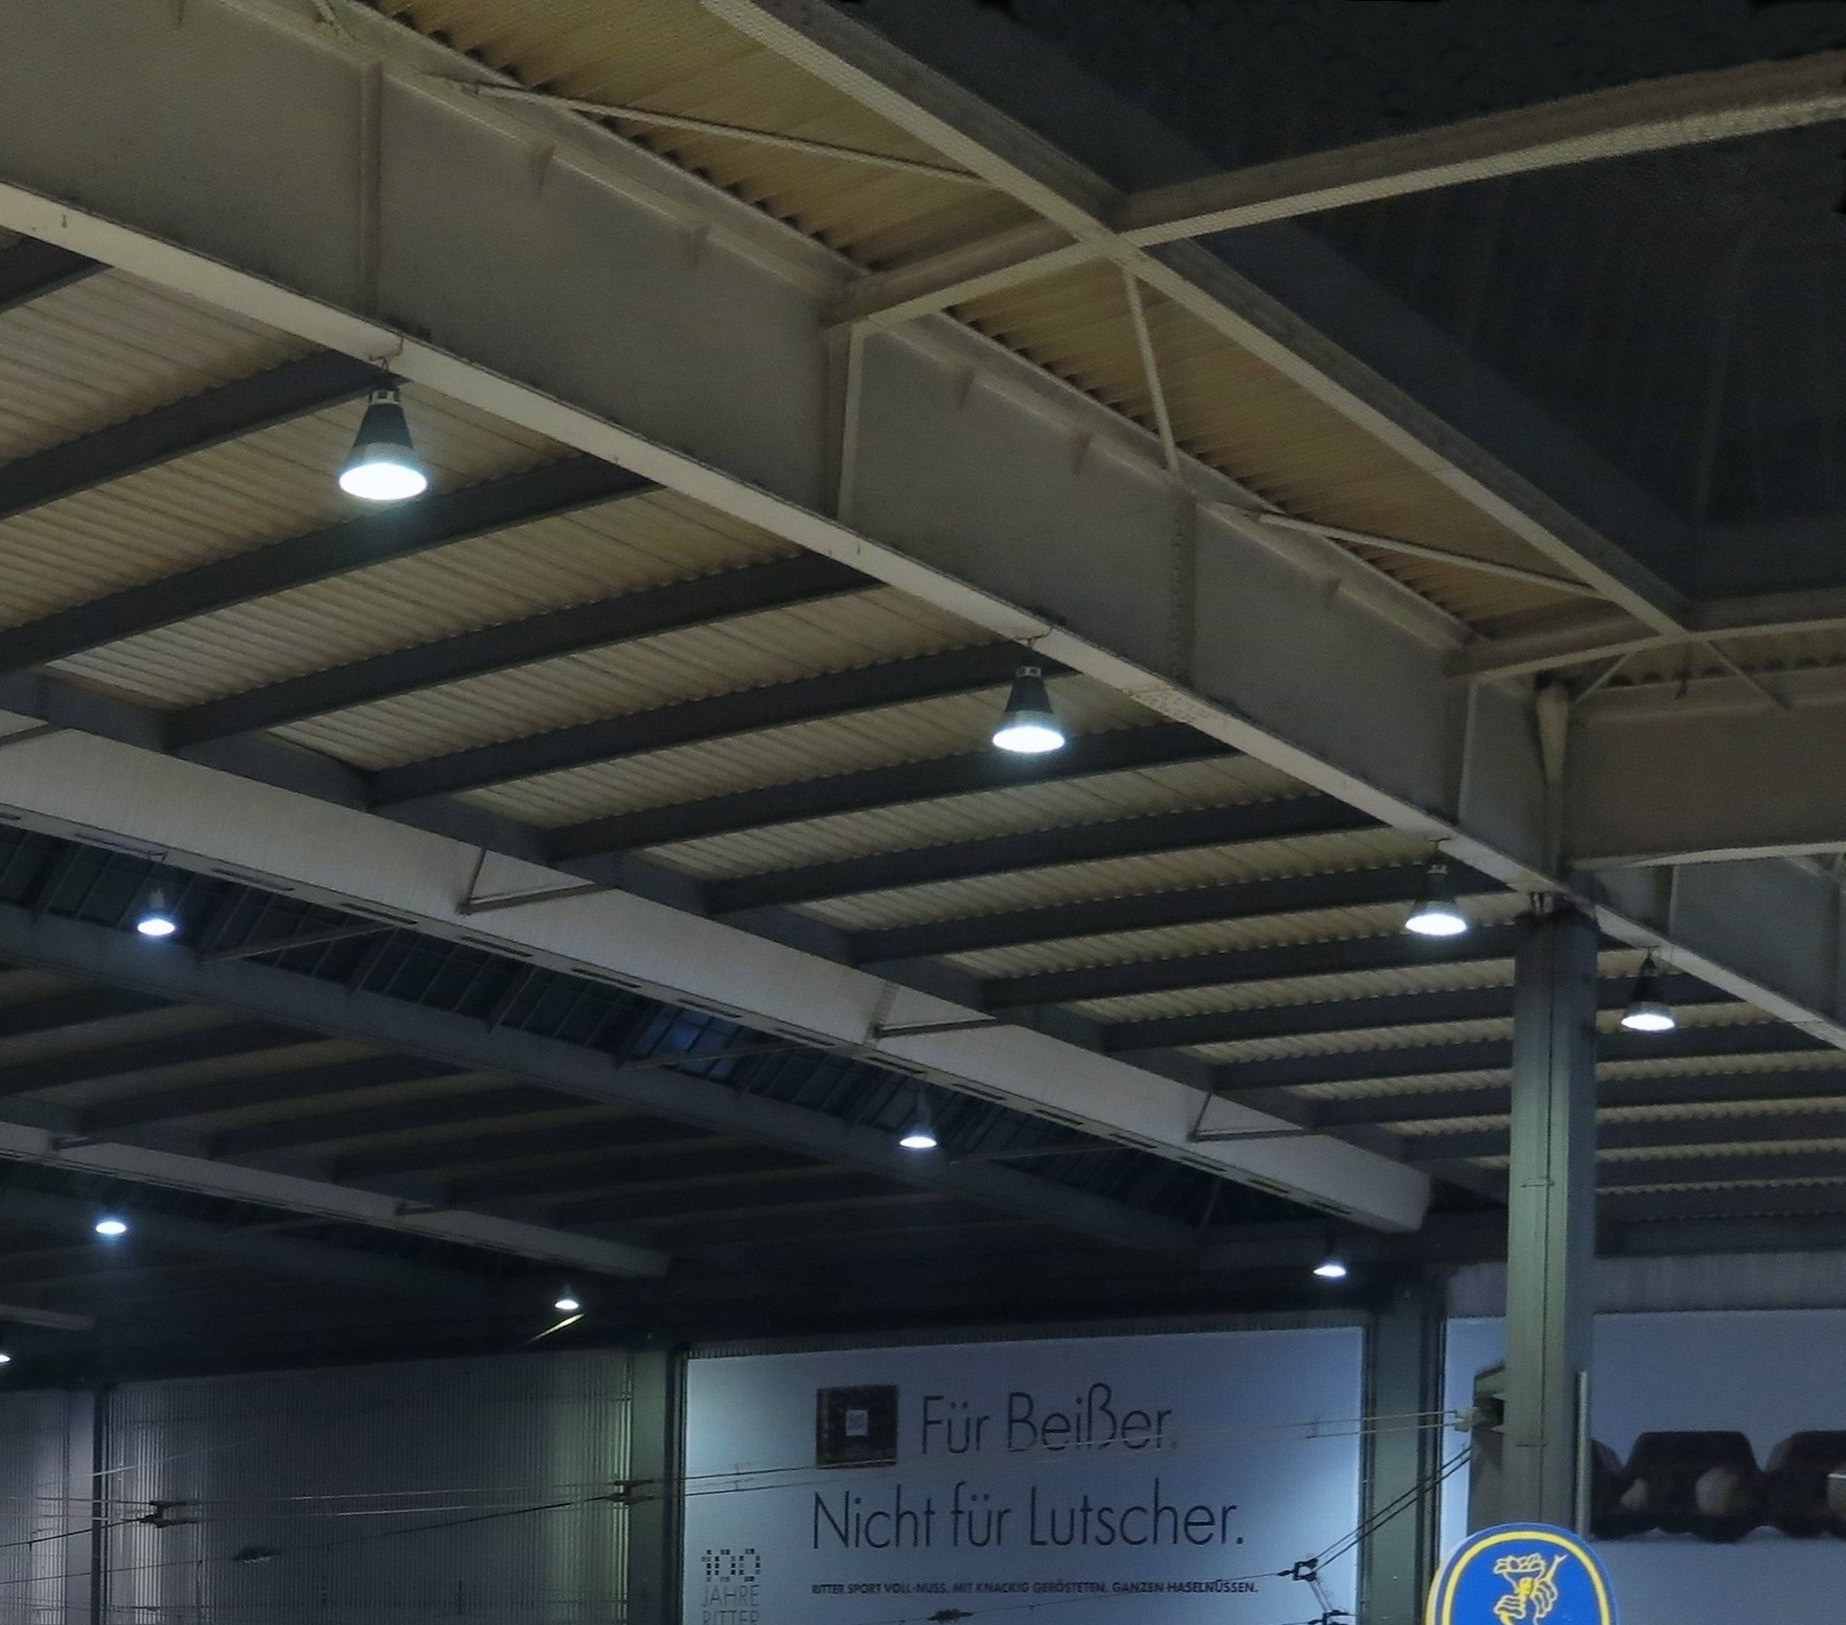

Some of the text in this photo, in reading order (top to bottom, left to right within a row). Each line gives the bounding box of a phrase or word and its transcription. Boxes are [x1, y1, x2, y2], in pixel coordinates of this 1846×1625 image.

[922, 1381, 1180, 1456] Für Beißer.
[813, 1477, 1246, 1550] Nicht für Lutscher.
[701, 1546, 761, 1583] 100
[702, 1583, 760, 1607] JAHRE
[812, 1583, 845, 1595] RITTER
[847, 1583, 881, 1594] SPORT
[953, 1582, 974, 1593] MIT
[976, 1582, 1030, 1593] KNACKIG
[1112, 1582, 1164, 1593] GANZEN
